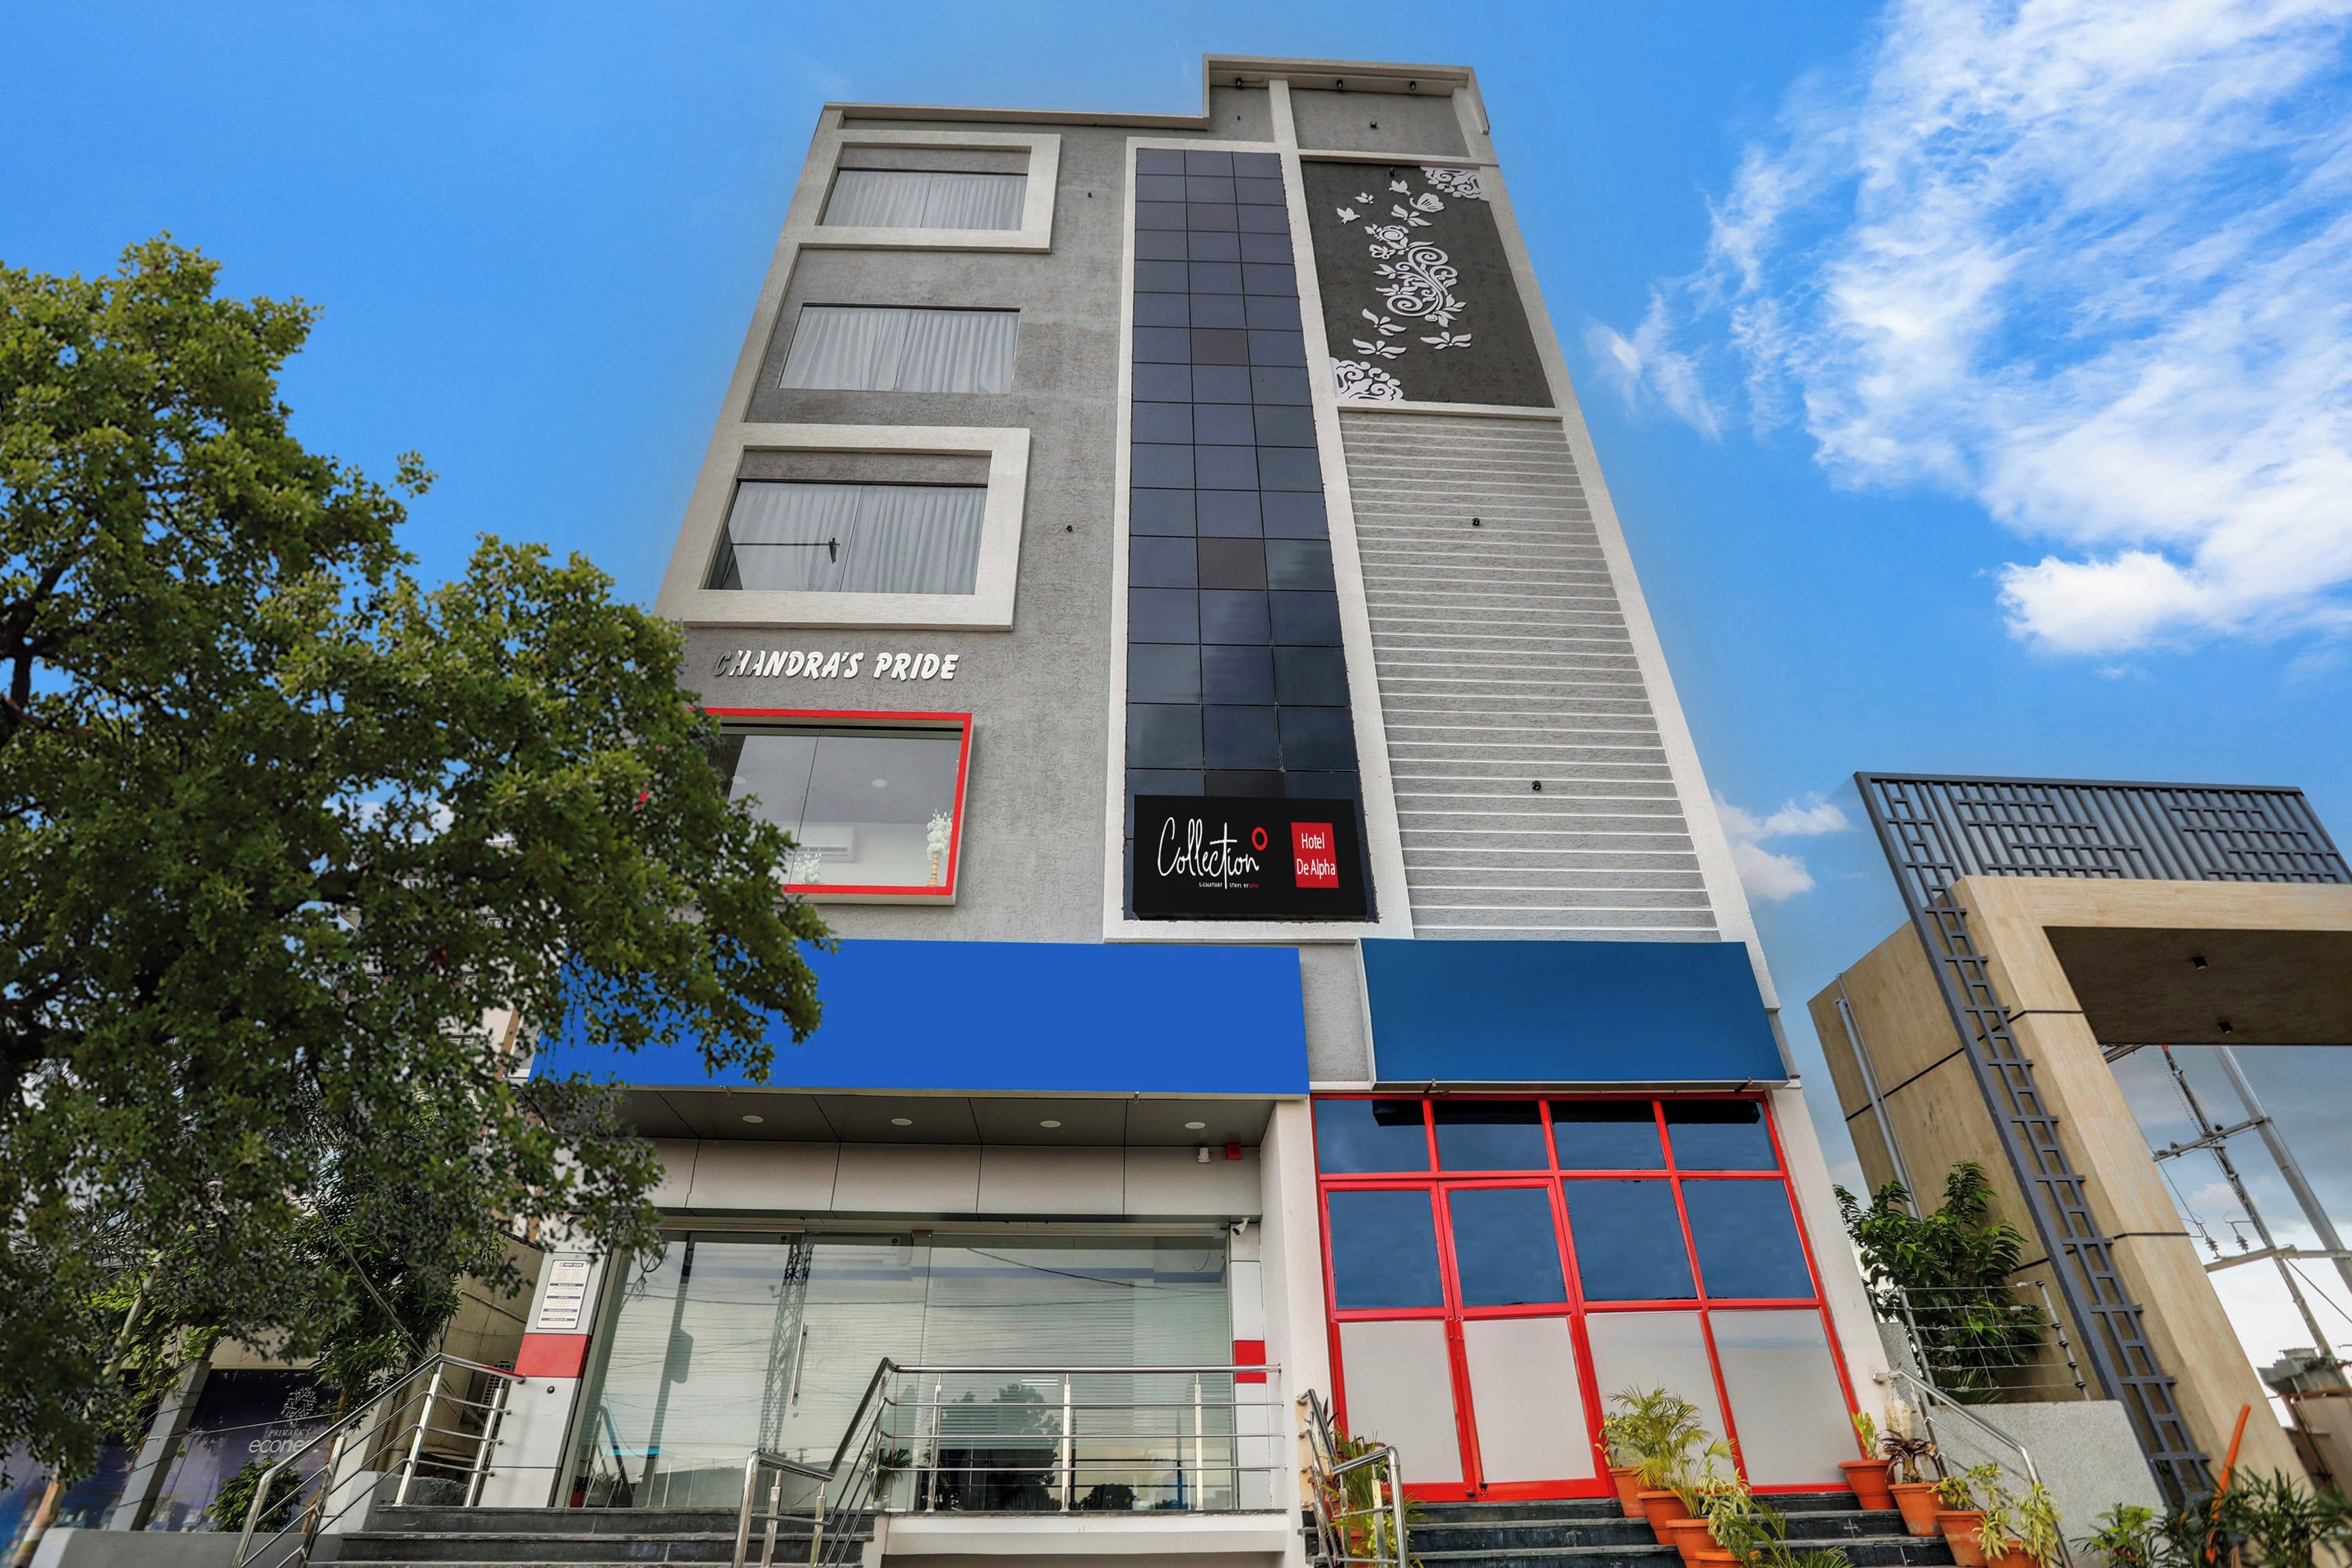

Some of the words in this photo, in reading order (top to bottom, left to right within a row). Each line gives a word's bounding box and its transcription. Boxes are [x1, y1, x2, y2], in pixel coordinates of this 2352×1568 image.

[873, 653, 958, 681] PRIDE
[1301, 832, 1324, 849] Hotel
[1158, 817, 1259, 889] Collection
[1296, 858, 1309, 875] De
[1311, 859, 1336, 879] Alpha
[248, 1439, 318, 1454] econe
